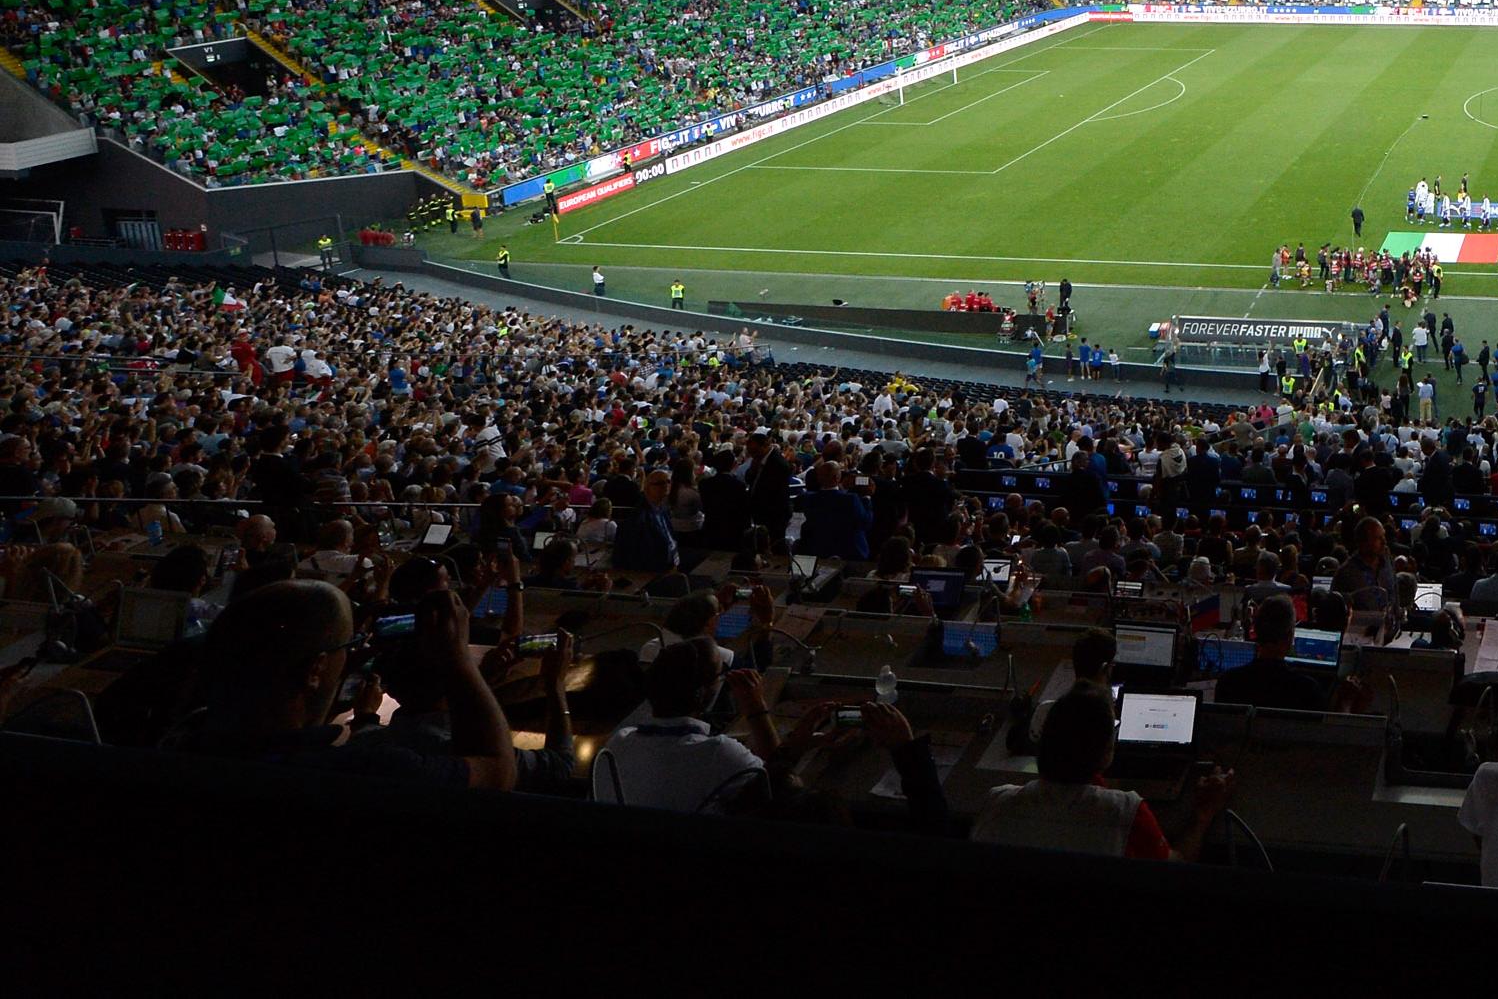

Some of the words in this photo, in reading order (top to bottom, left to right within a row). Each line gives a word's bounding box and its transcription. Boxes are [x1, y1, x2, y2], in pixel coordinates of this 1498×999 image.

[730, 125, 775, 147] www.figc.it
[559, 189, 596, 210] EUROPEAN
[597, 176, 633, 196] QUALIFIERS
